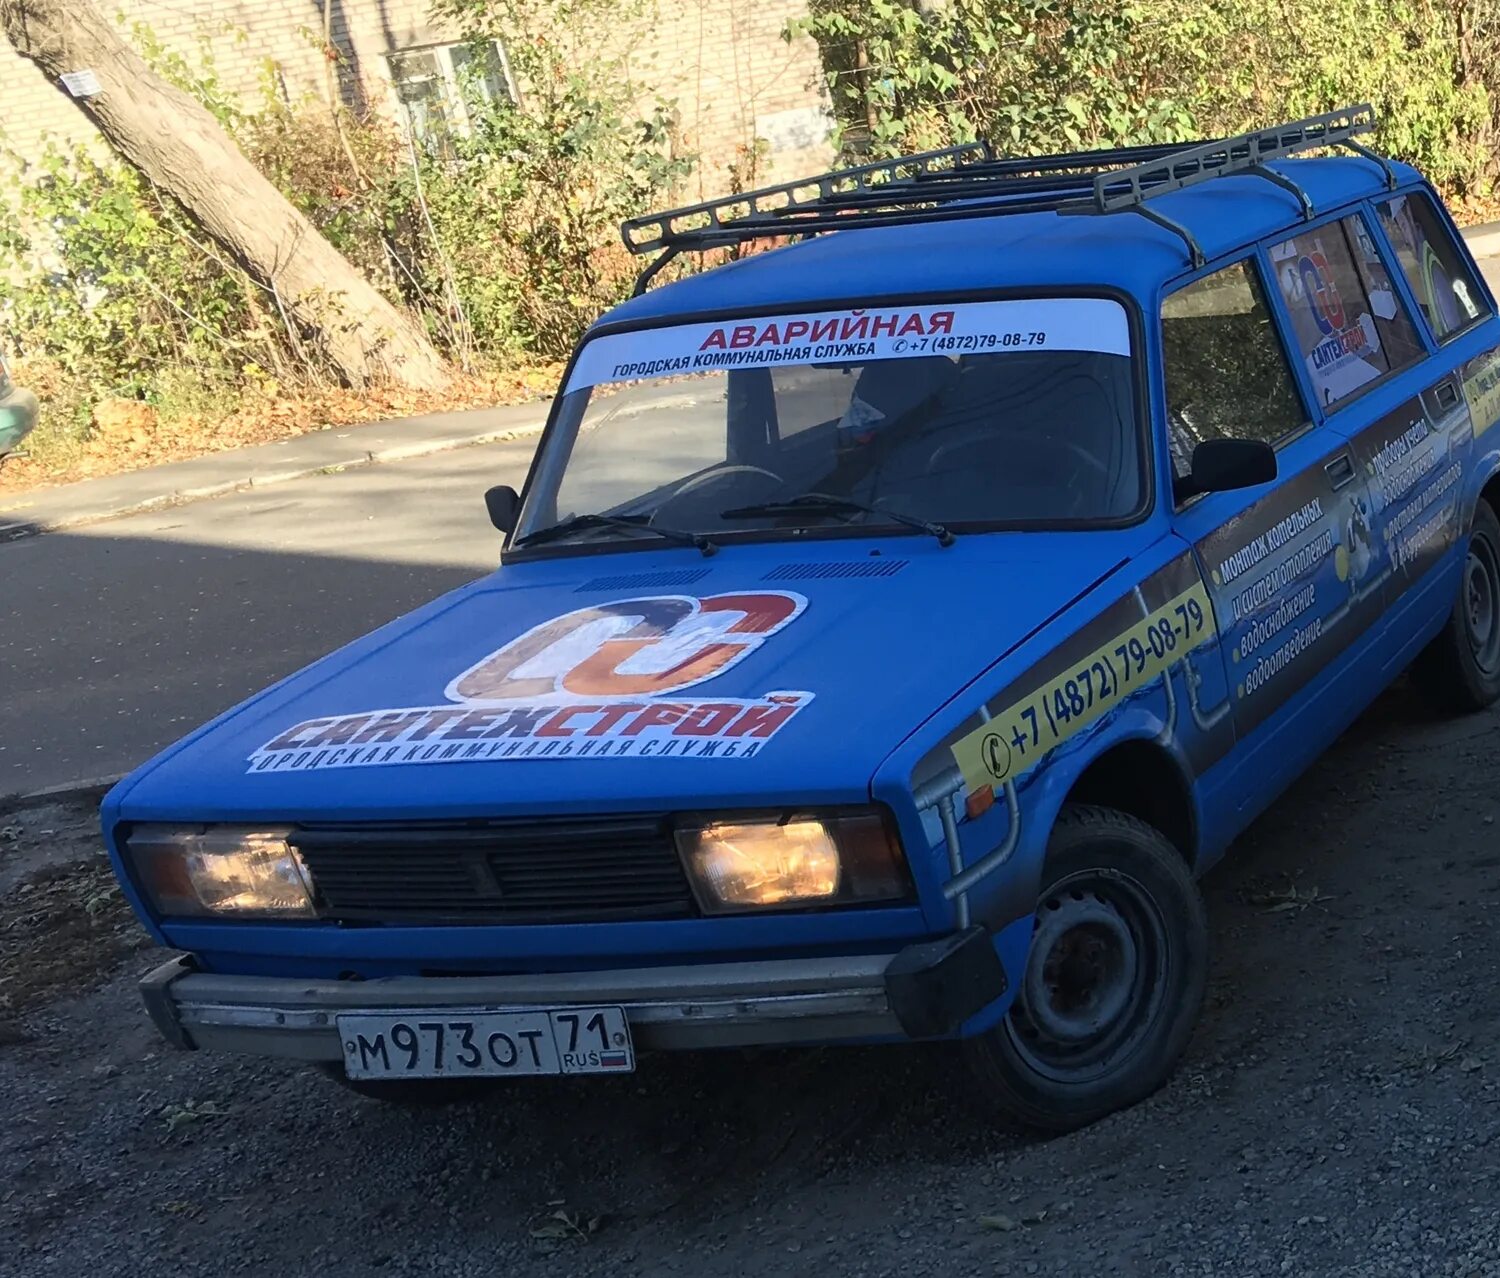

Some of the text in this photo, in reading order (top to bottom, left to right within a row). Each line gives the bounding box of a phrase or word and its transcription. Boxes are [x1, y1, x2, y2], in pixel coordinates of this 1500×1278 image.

[699, 309, 956, 351] АВАРИЙНАЯ
[612, 356, 690, 378] ГОРОДСКАЯ
[692, 348, 811, 367] КОММУНАЛЬНАЯ
[814, 342, 876, 359] СЛУЖБА
[910, 338, 929, 351] +7
[1220, 497, 1324, 584] монтаж котельных
[1232, 529, 1333, 621] и систем отопления
[1240, 583, 1316, 658] водоснабжение
[1011, 598, 1204, 755] +7 (4872) 79-08-79
[1245, 617, 1322, 695] водоотведение
[264, 695, 798, 751] САНТЕХСТРОЙ
[402, 739, 635, 761] КОММУНАЛЬНАЯ
[639, 739, 760, 757] СЛУЖБА
[357, 1023, 543, 1070] М973ОТ
[557, 1014, 610, 1051] 71
[563, 1051, 601, 1067] RUS
